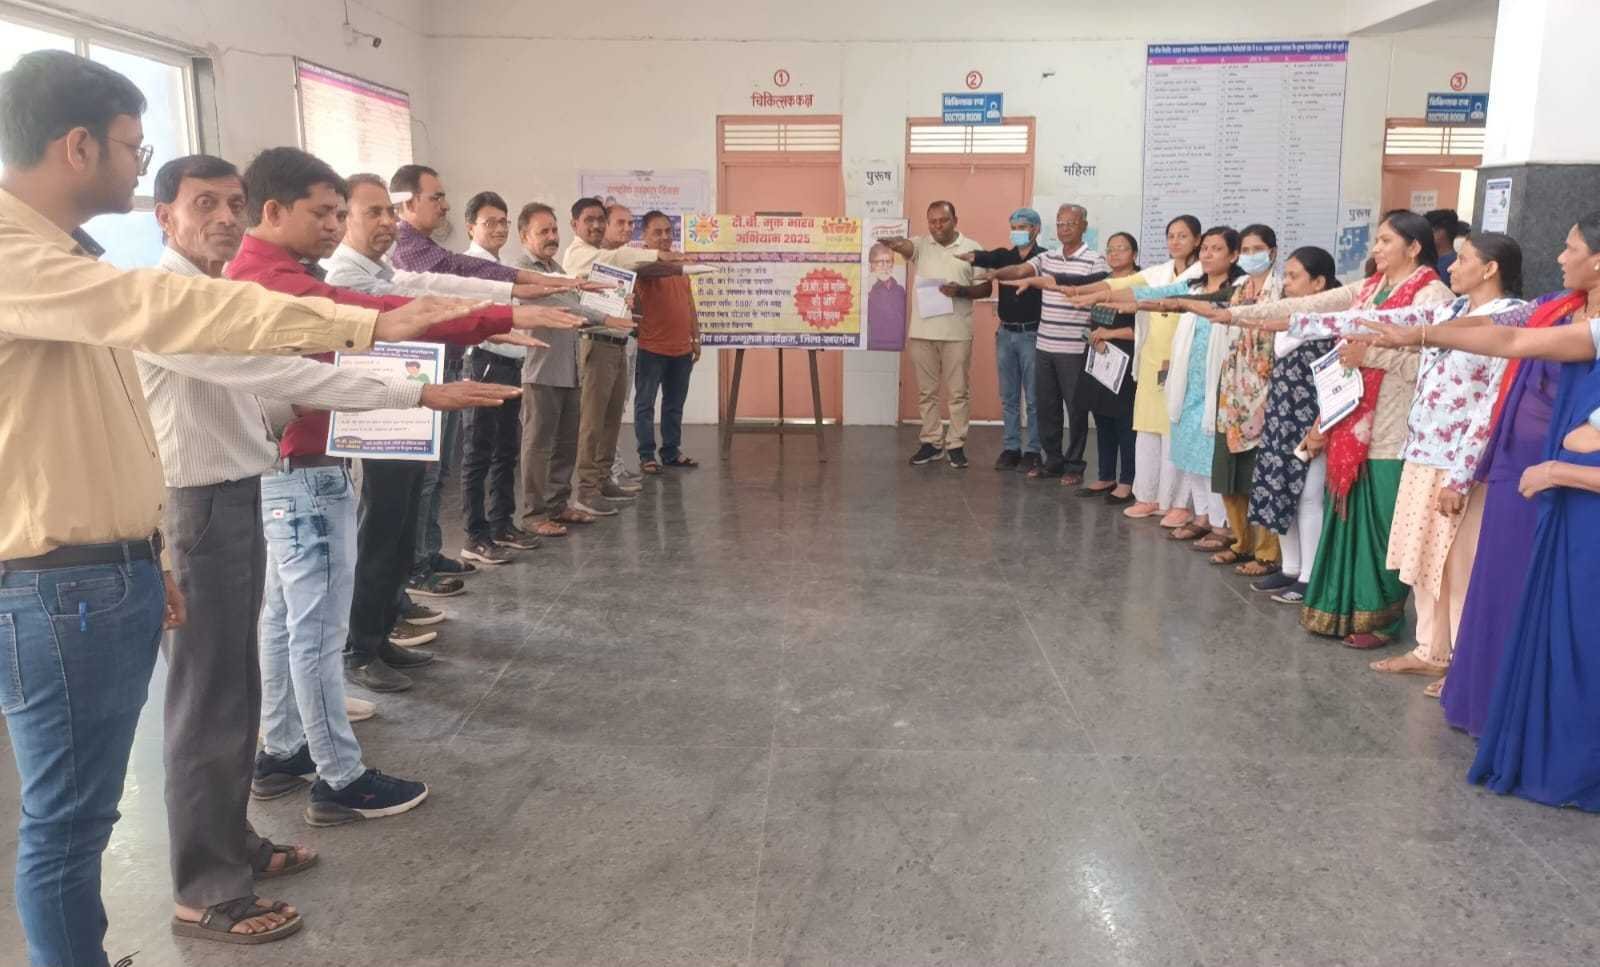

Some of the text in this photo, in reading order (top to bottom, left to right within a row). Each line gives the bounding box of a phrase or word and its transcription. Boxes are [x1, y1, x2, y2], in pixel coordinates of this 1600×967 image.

[1063, 162, 1096, 177] महिला
[787, 218, 814, 228] भारत
[736, 231, 780, 243] अभियान
[783, 233, 810, 244] 2025
